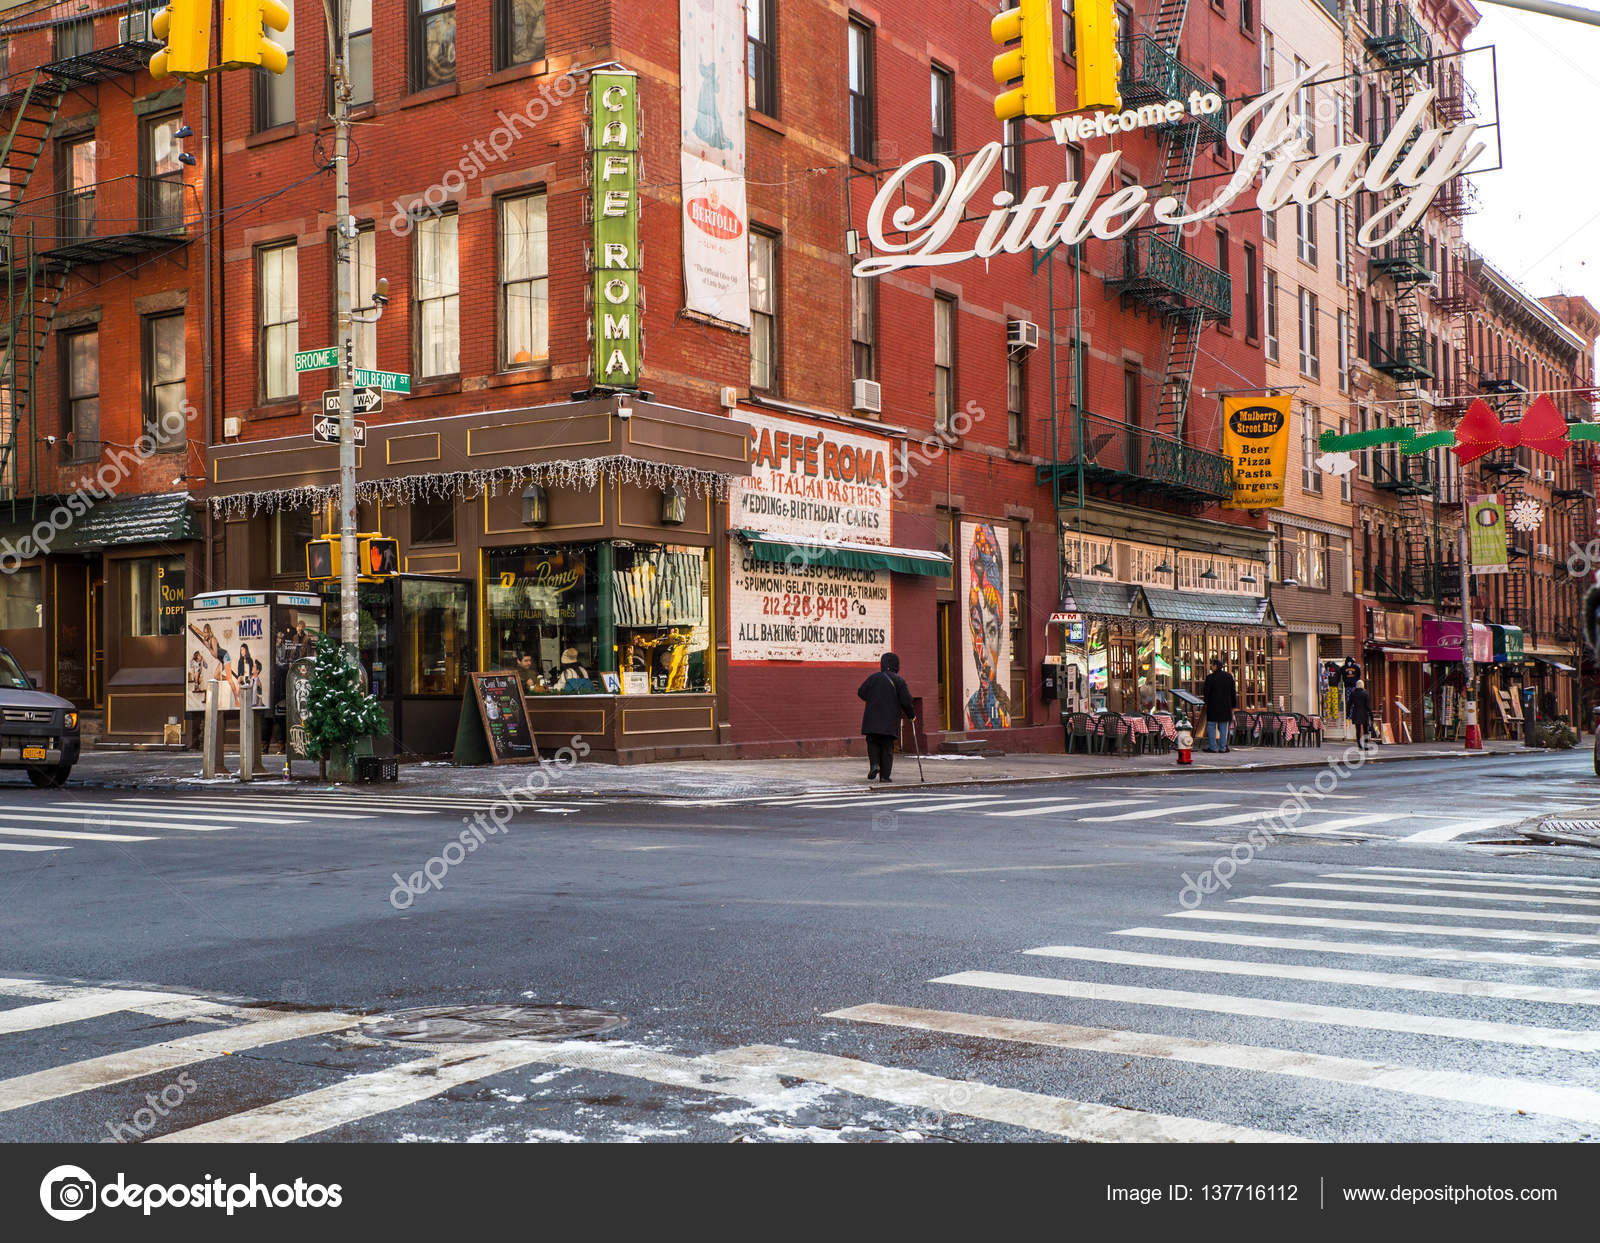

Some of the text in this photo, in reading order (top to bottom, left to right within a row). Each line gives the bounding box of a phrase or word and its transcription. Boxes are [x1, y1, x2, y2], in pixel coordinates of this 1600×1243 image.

[1051, 89, 1222, 145] Welcome to
[602, 85, 629, 217] CAFE
[852, 60, 1487, 278] Little Italy
[692, 202, 738, 234] BERTOLLI
[604, 243, 631, 377] ROMA
[295, 349, 337, 369] BROOME ST
[354, 368, 408, 389] MULBERRY ST
[328, 395, 375, 408] ON WAY
[1240, 411, 1278, 422] Mulberry
[319, 424, 336, 435] ONE
[1237, 422, 1278, 433] Street Bar
[1242, 444, 1269, 454] Beer
[823, 441, 887, 488] ROMA
[1238, 457, 1271, 466] Pizza
[1237, 469, 1272, 478] Pasta
[771, 471, 824, 502] ITALIAN
[827, 482, 881, 508] PASTRIES
[846, 509, 879, 529] CAKES
[742, 559, 770, 574] CAFFE
[536, 561, 579, 598] Roma
[289, 596, 311, 605] TITAN
[763, 596, 780, 616] 212
[238, 618, 263, 637] MICK
[739, 623, 760, 641] ALL
[801, 626, 825, 644] DONE
[826, 626, 839, 644] ON
[840, 627, 885, 644] PREMISES
